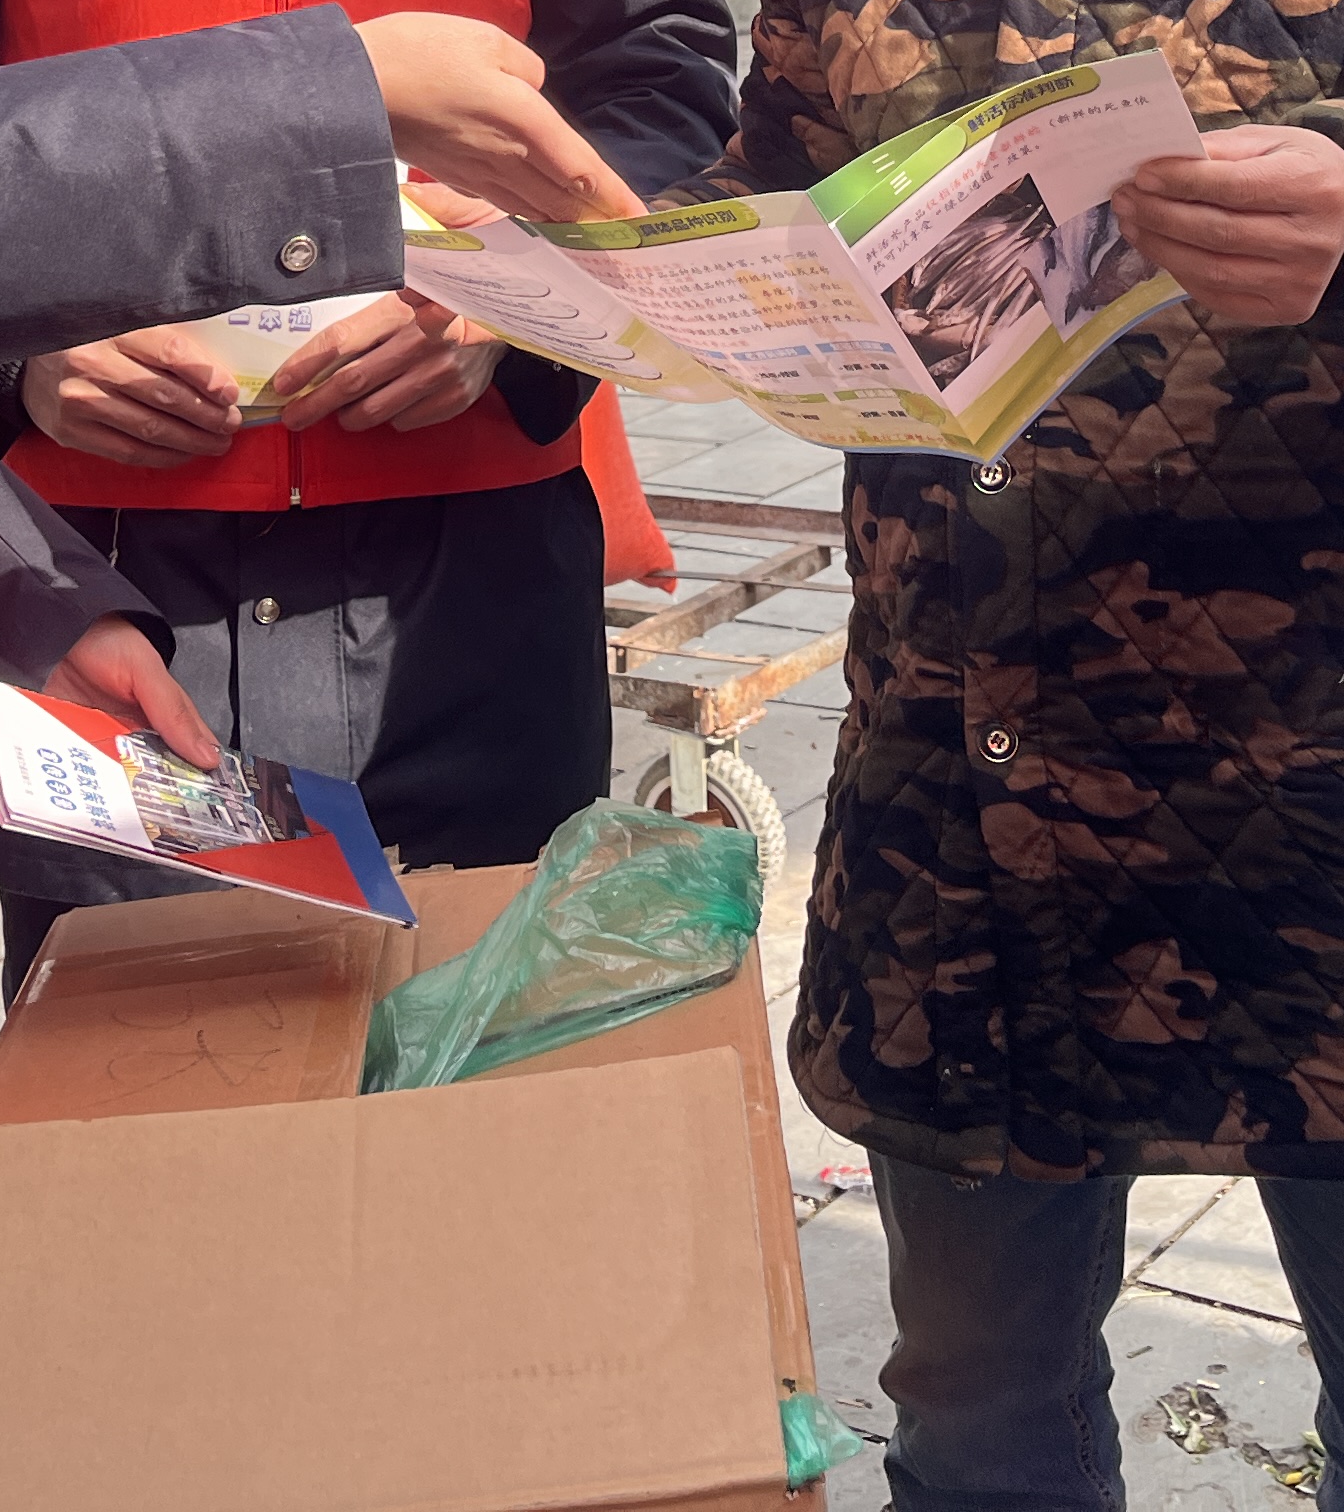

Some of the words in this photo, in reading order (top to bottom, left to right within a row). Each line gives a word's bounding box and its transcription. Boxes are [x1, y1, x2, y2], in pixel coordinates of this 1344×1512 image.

[967, 74, 1074, 133] 鲜活标准判断
[639, 209, 738, 237] 具体品种识别
[228, 306, 313, 332] 一本通
